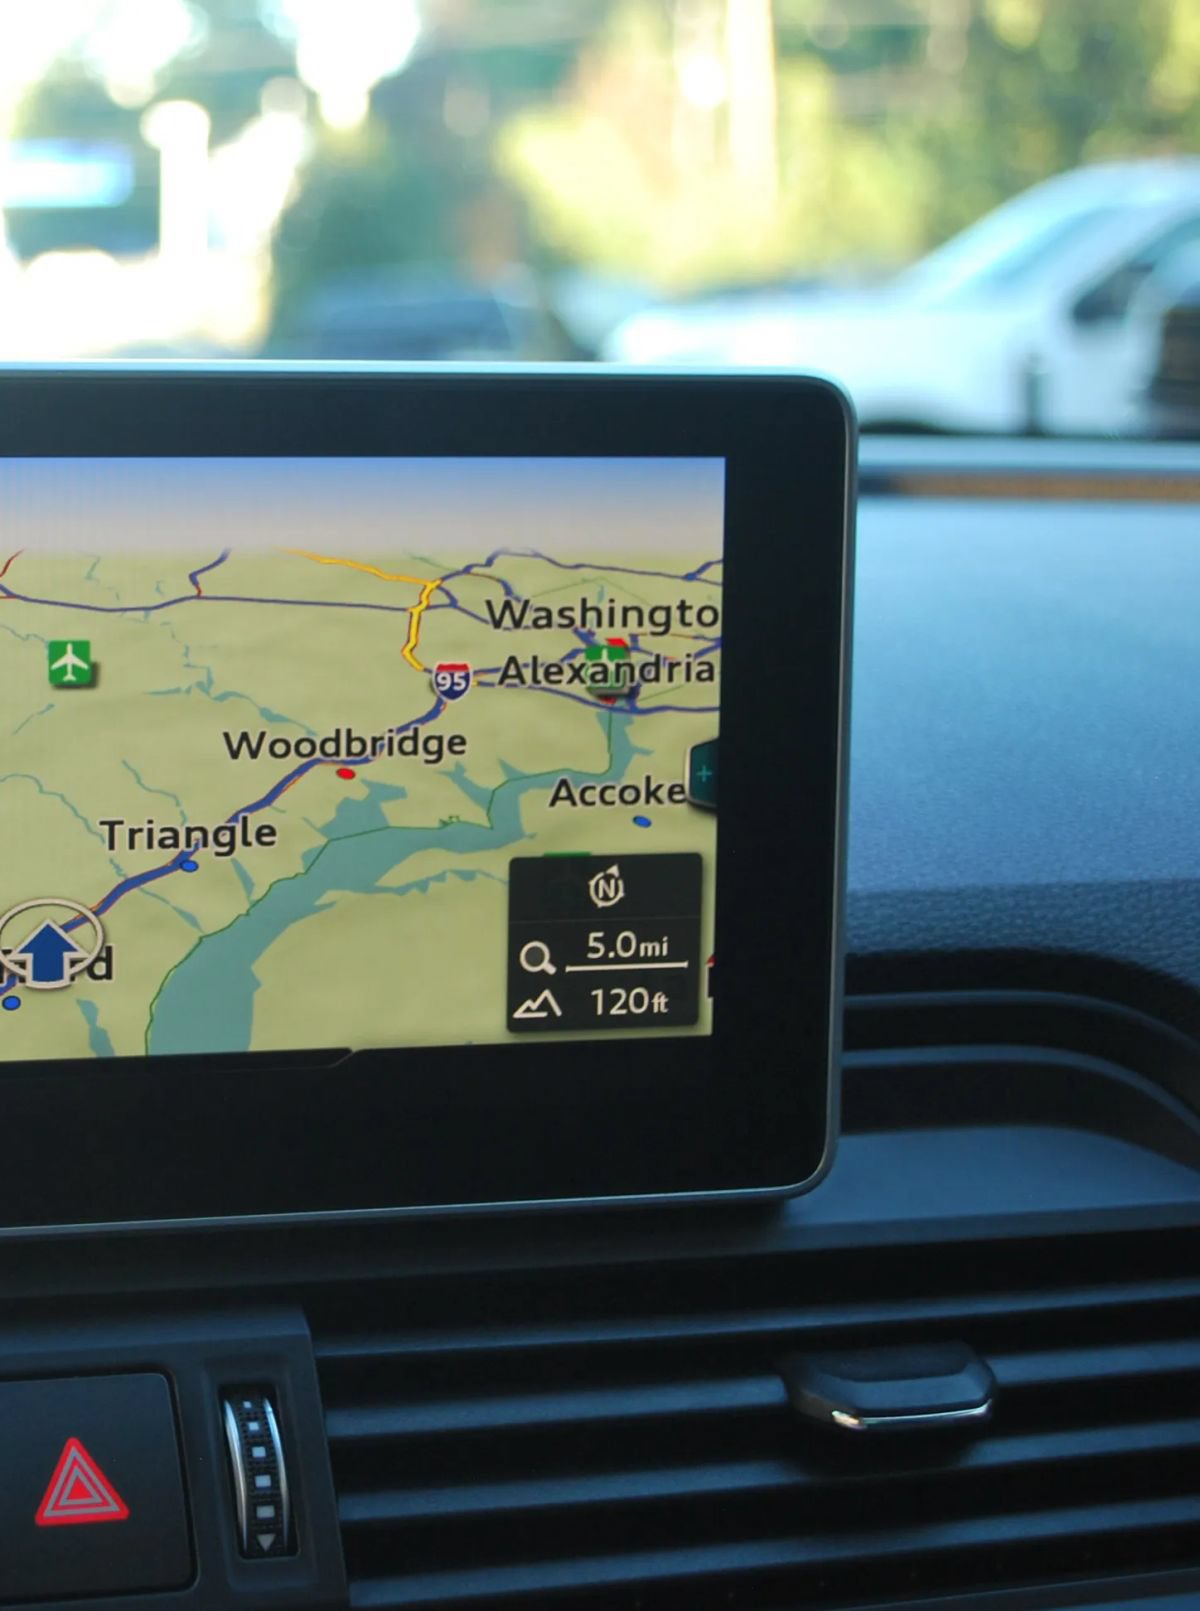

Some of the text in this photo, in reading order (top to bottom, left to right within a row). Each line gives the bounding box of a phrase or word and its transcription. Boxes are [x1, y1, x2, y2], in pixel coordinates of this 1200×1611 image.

[486, 599, 720, 634] Washingto
[435, 673, 467, 691] 95
[500, 655, 716, 686] Alexandria
[223, 729, 467, 764] Woodbridge
[549, 776, 686, 807] Accoke
[100, 816, 277, 855] Triangle
